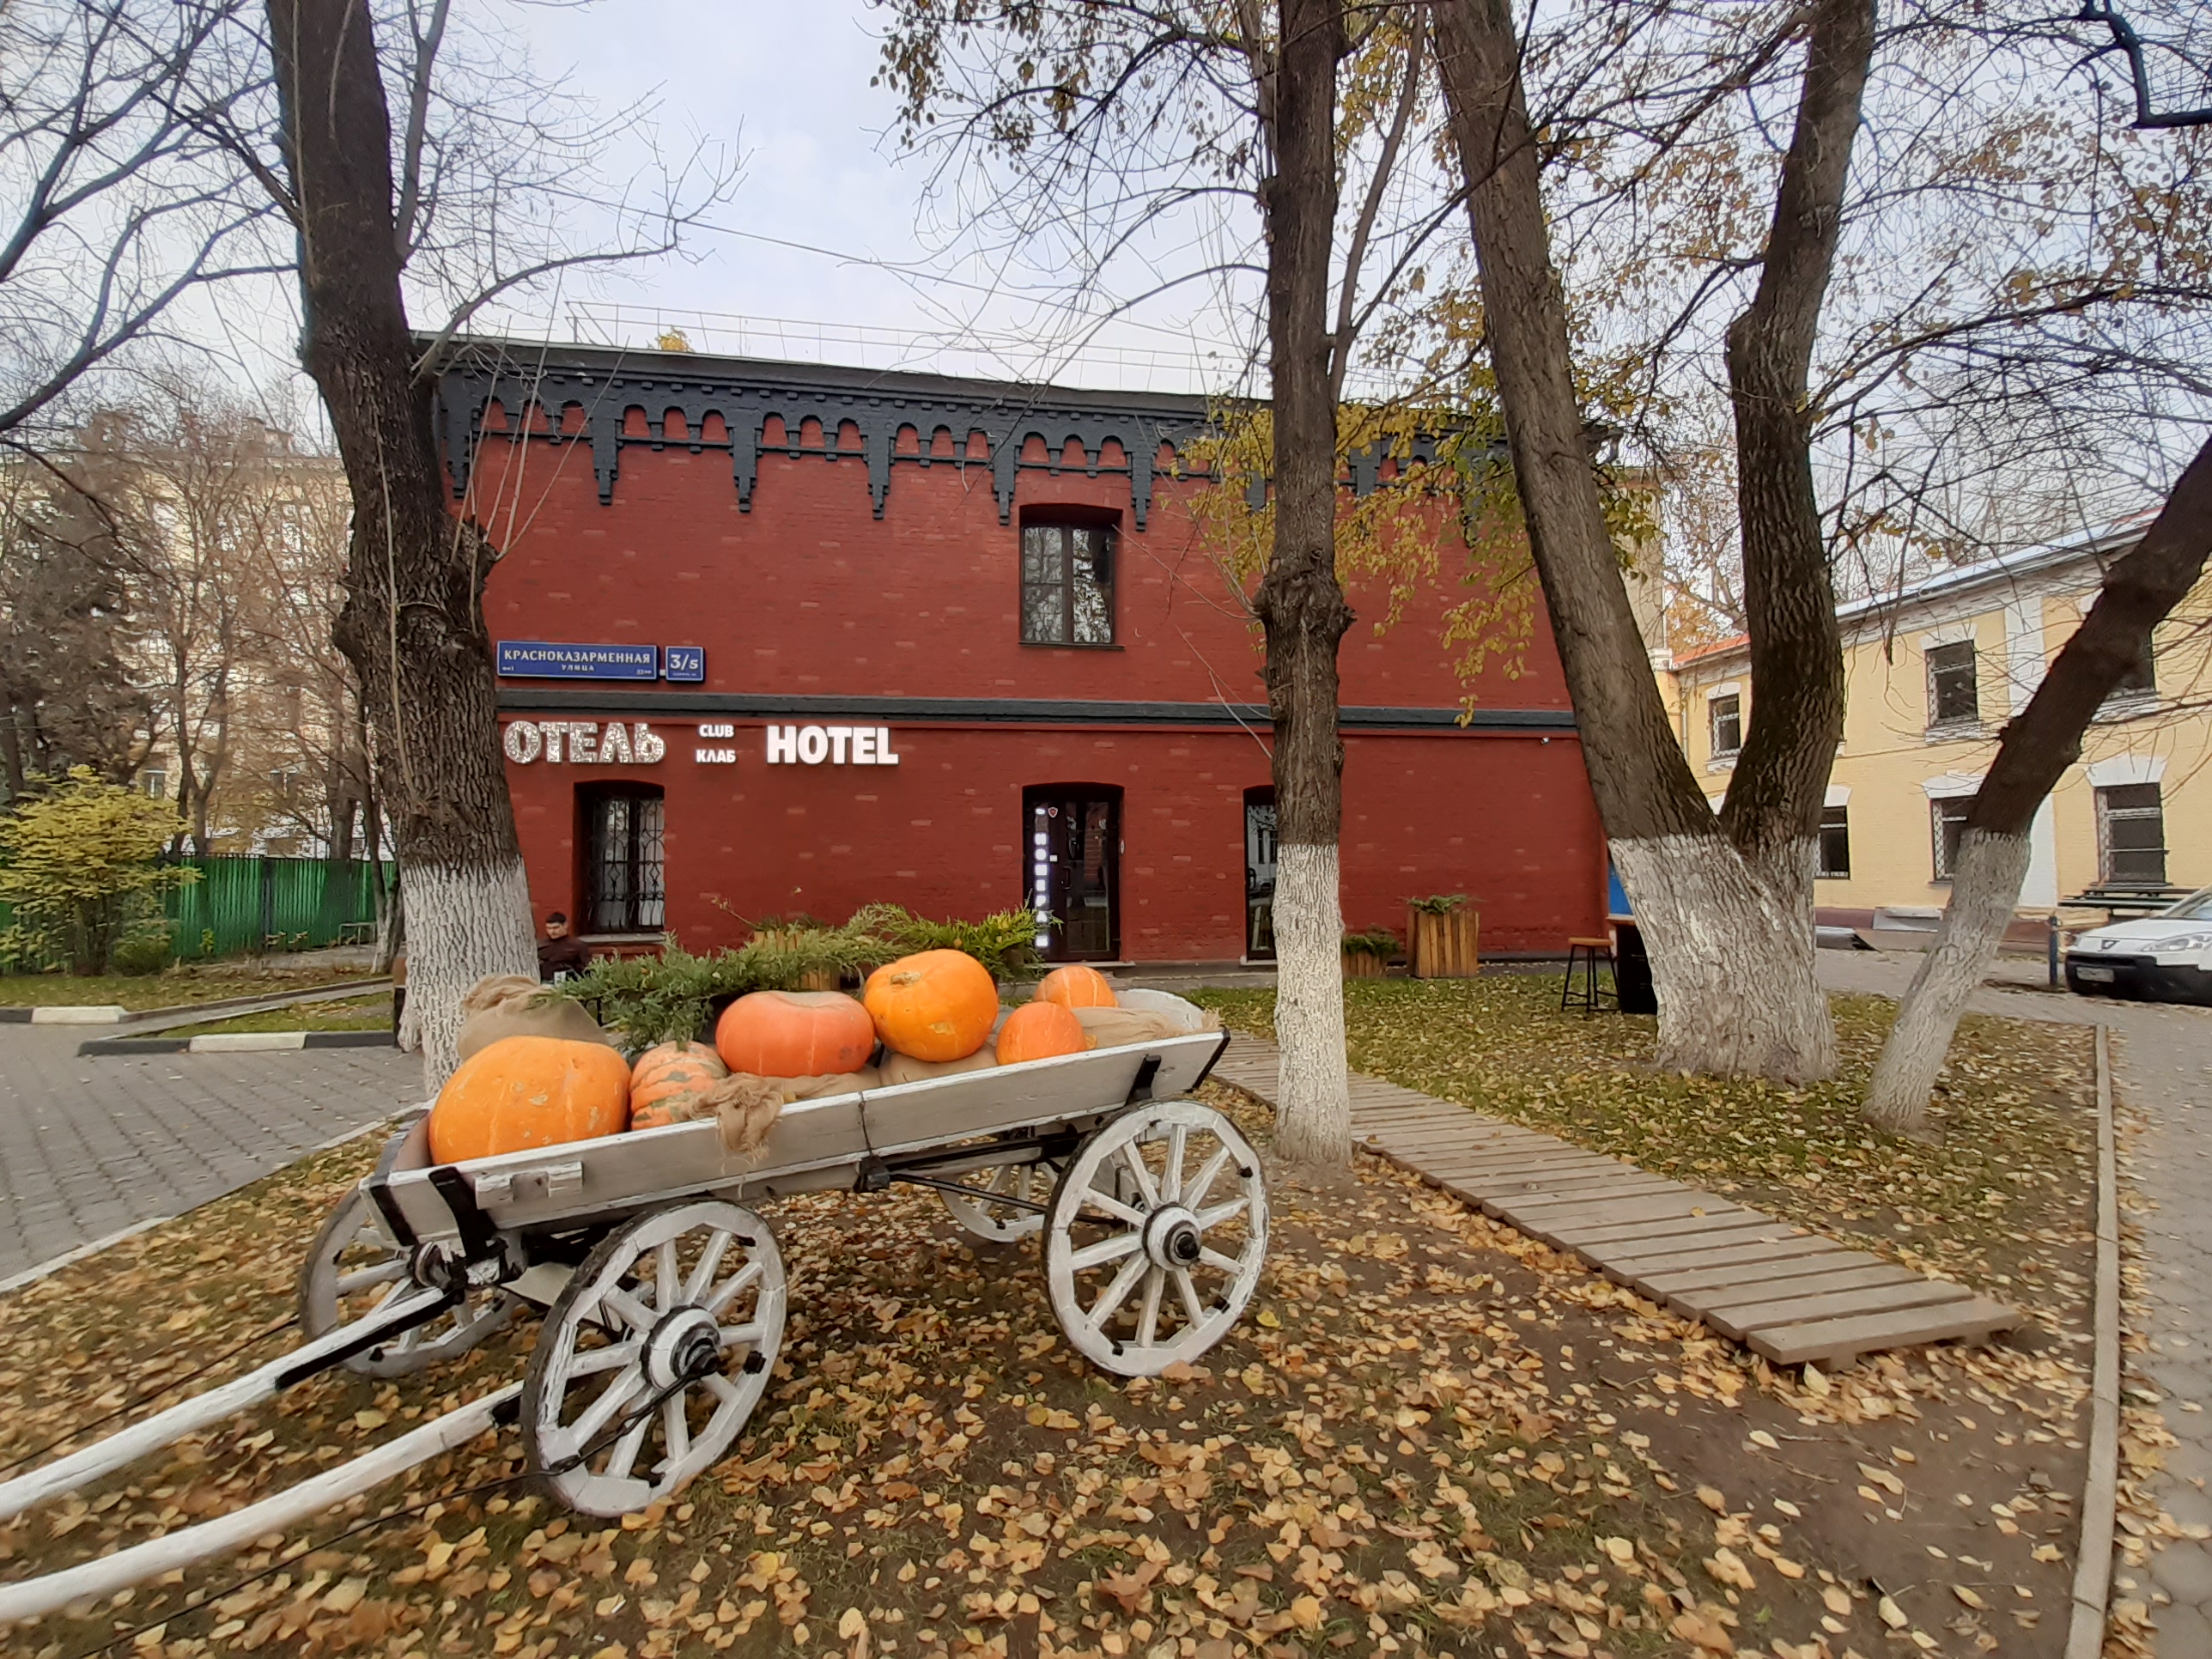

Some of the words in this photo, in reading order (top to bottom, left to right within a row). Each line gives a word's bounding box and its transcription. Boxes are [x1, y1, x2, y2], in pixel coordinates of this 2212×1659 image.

[503, 649, 651, 665] КРАСНОКАЗАРМЕННАЯ
[670, 653, 699, 671] 3/5
[561, 664, 595, 672] УЛИЦА
[698, 725, 735, 738] CLUB
[503, 720, 666, 764] ОТЕЛЬ
[767, 726, 899, 764] HOTEL
[696, 749, 737, 763] КЛАБ
